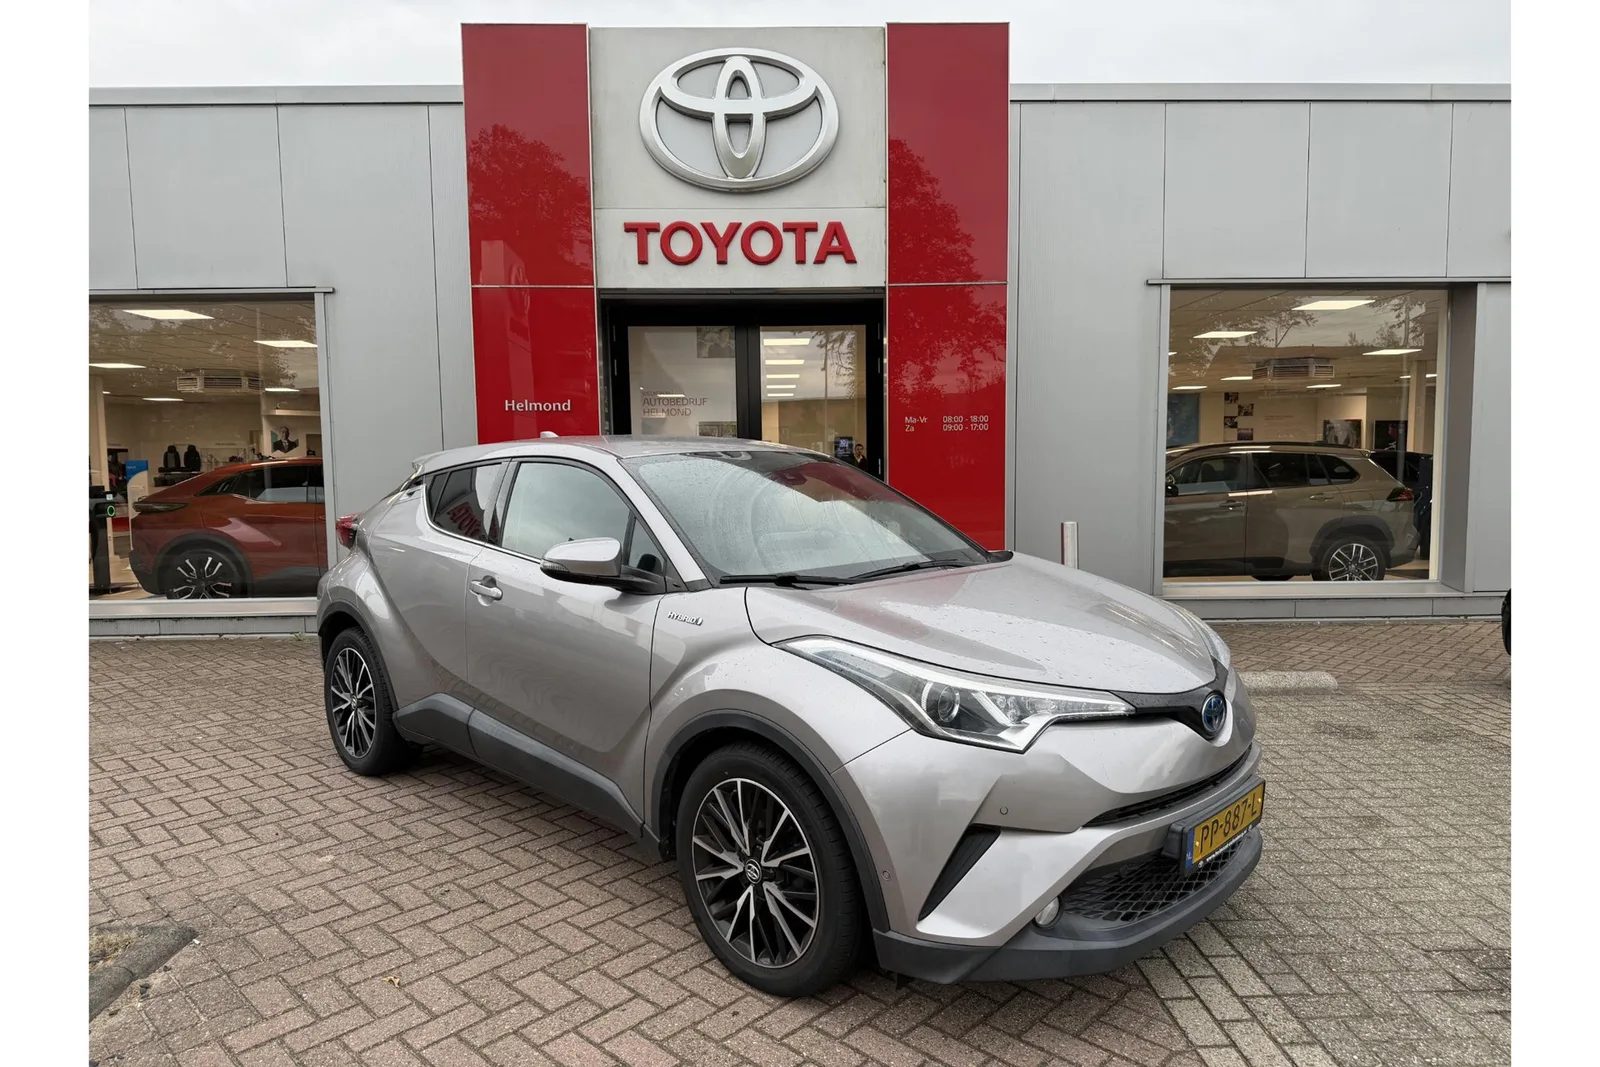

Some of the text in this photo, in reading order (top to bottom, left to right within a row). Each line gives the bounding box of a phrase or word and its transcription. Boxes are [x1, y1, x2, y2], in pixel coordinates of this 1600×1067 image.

[623, 220, 858, 266] TOYOTA
[504, 399, 571, 411] Helmond
[642, 397, 709, 407] AUTOBEDRIJF
[643, 407, 692, 417] HELMOND
[904, 416, 928, 424] Ma-Vr
[942, 415, 964, 423] 08:00
[969, 415, 989, 423] 18:00
[905, 424, 915, 432] Za
[942, 423, 964, 431] 09:00
[970, 423, 989, 431] 17:00
[667, 611, 697, 625] HYBRID
[1200, 792, 1257, 854] PP-887-L
